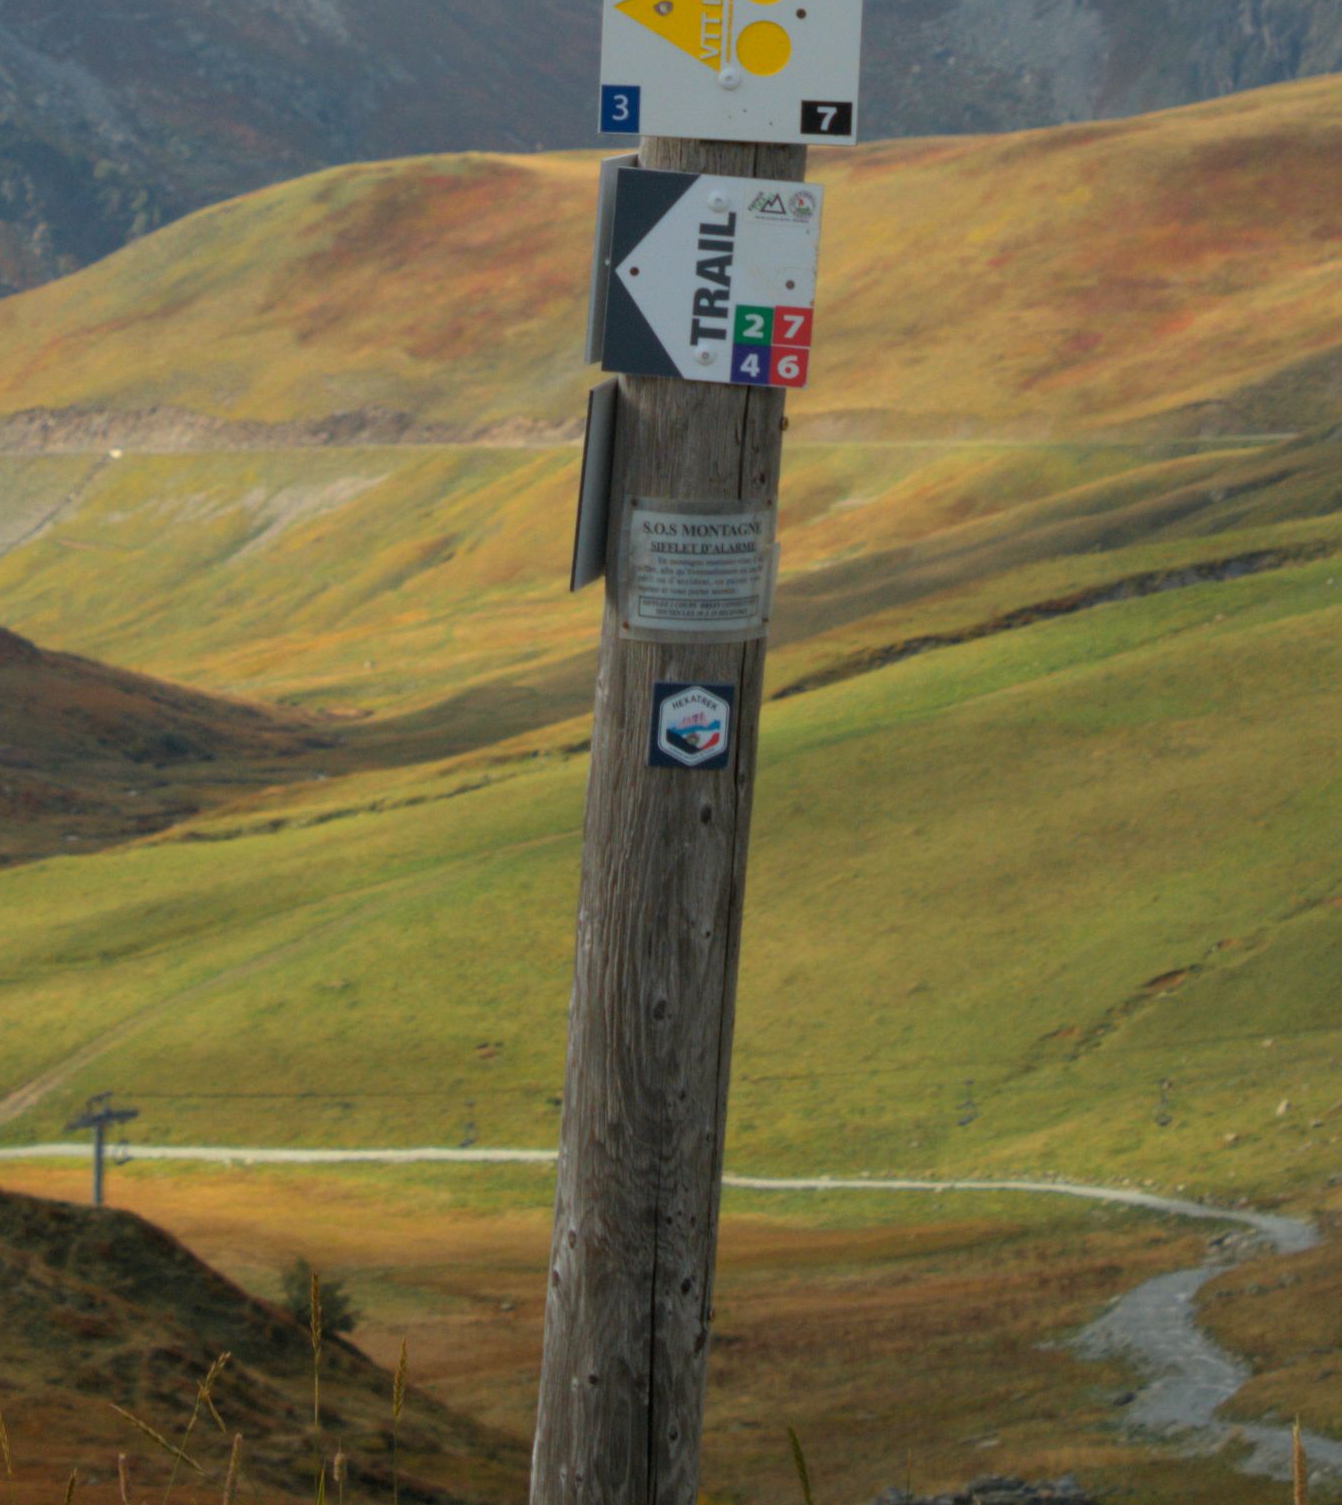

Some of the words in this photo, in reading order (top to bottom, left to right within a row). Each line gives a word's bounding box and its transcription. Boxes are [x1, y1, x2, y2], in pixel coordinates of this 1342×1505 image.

[700, 12, 721, 61] VTT
[612, 95, 629, 121] 3
[817, 107, 837, 131] 7
[690, 212, 736, 346] TRAIL
[743, 314, 764, 337] 2
[783, 315, 804, 338] 7
[740, 354, 760, 376] 4
[778, 355, 799, 378] 6
[672, 695, 717, 709] HEXATREK
